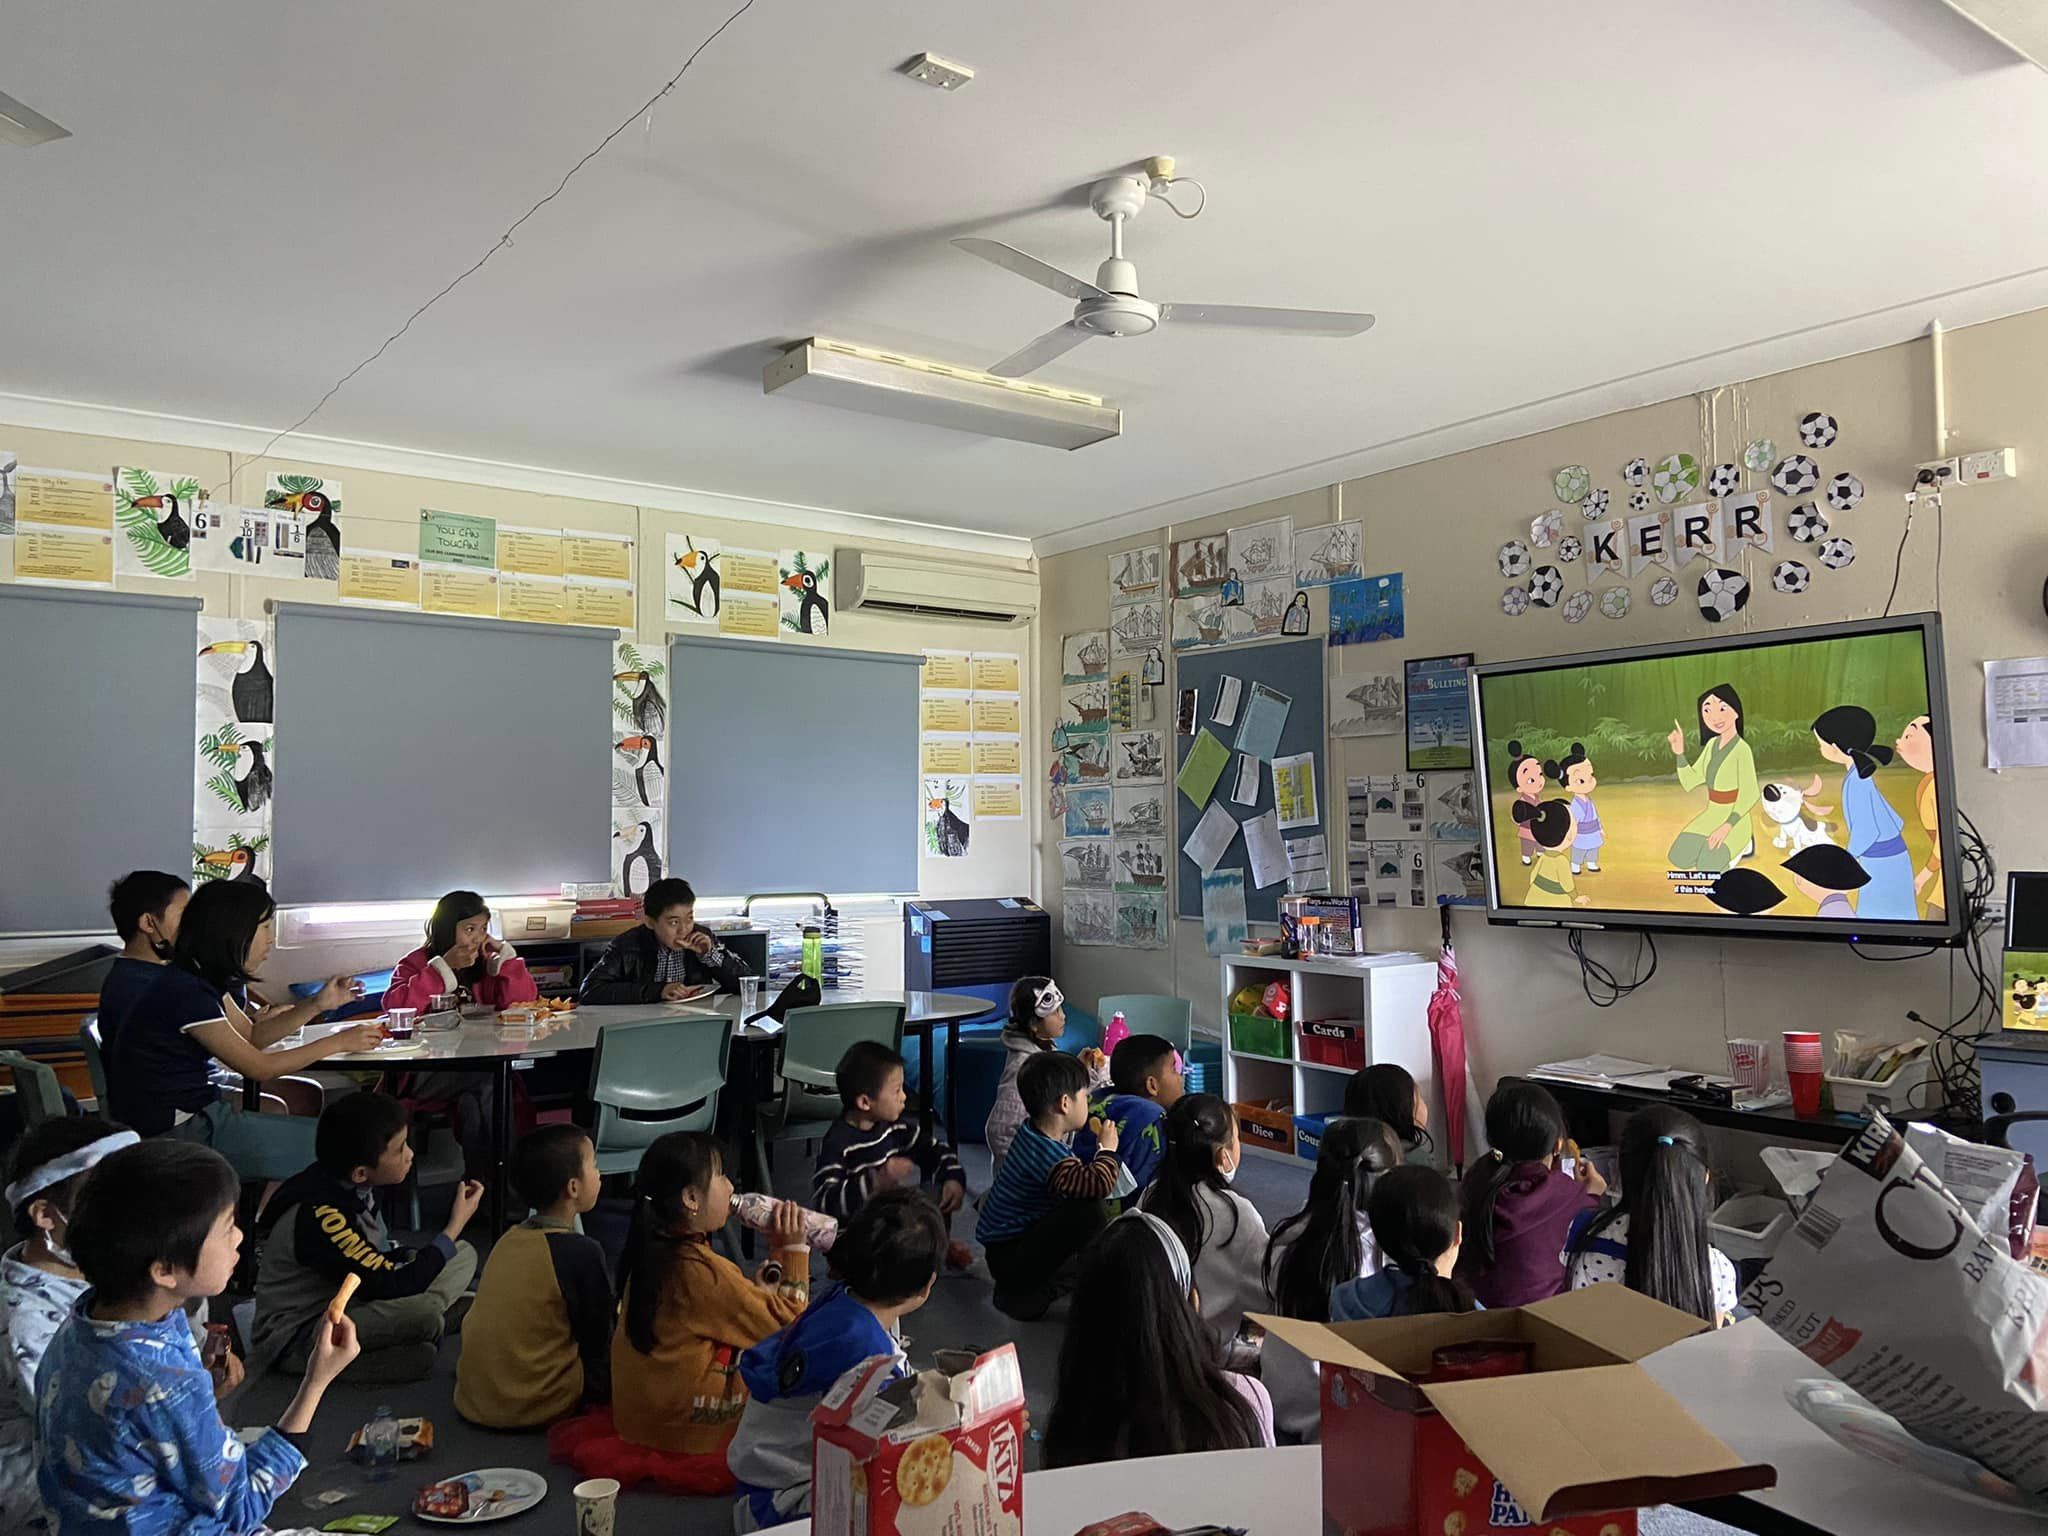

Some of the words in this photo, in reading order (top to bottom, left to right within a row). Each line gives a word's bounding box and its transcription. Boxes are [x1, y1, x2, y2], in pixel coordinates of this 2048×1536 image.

[195, 513, 207, 529] 6
[436, 524, 456, 535] YOU
[1594, 506, 1761, 563] KERR
[1427, 678, 1467, 690] BULLYING
[1416, 773, 1425, 788] 6
[1413, 852, 1423, 868] 6
[1312, 1024, 1345, 1038] Cards
[1252, 1123, 1274, 1139] Dice
[1797, 1313, 1821, 1339] CUT
